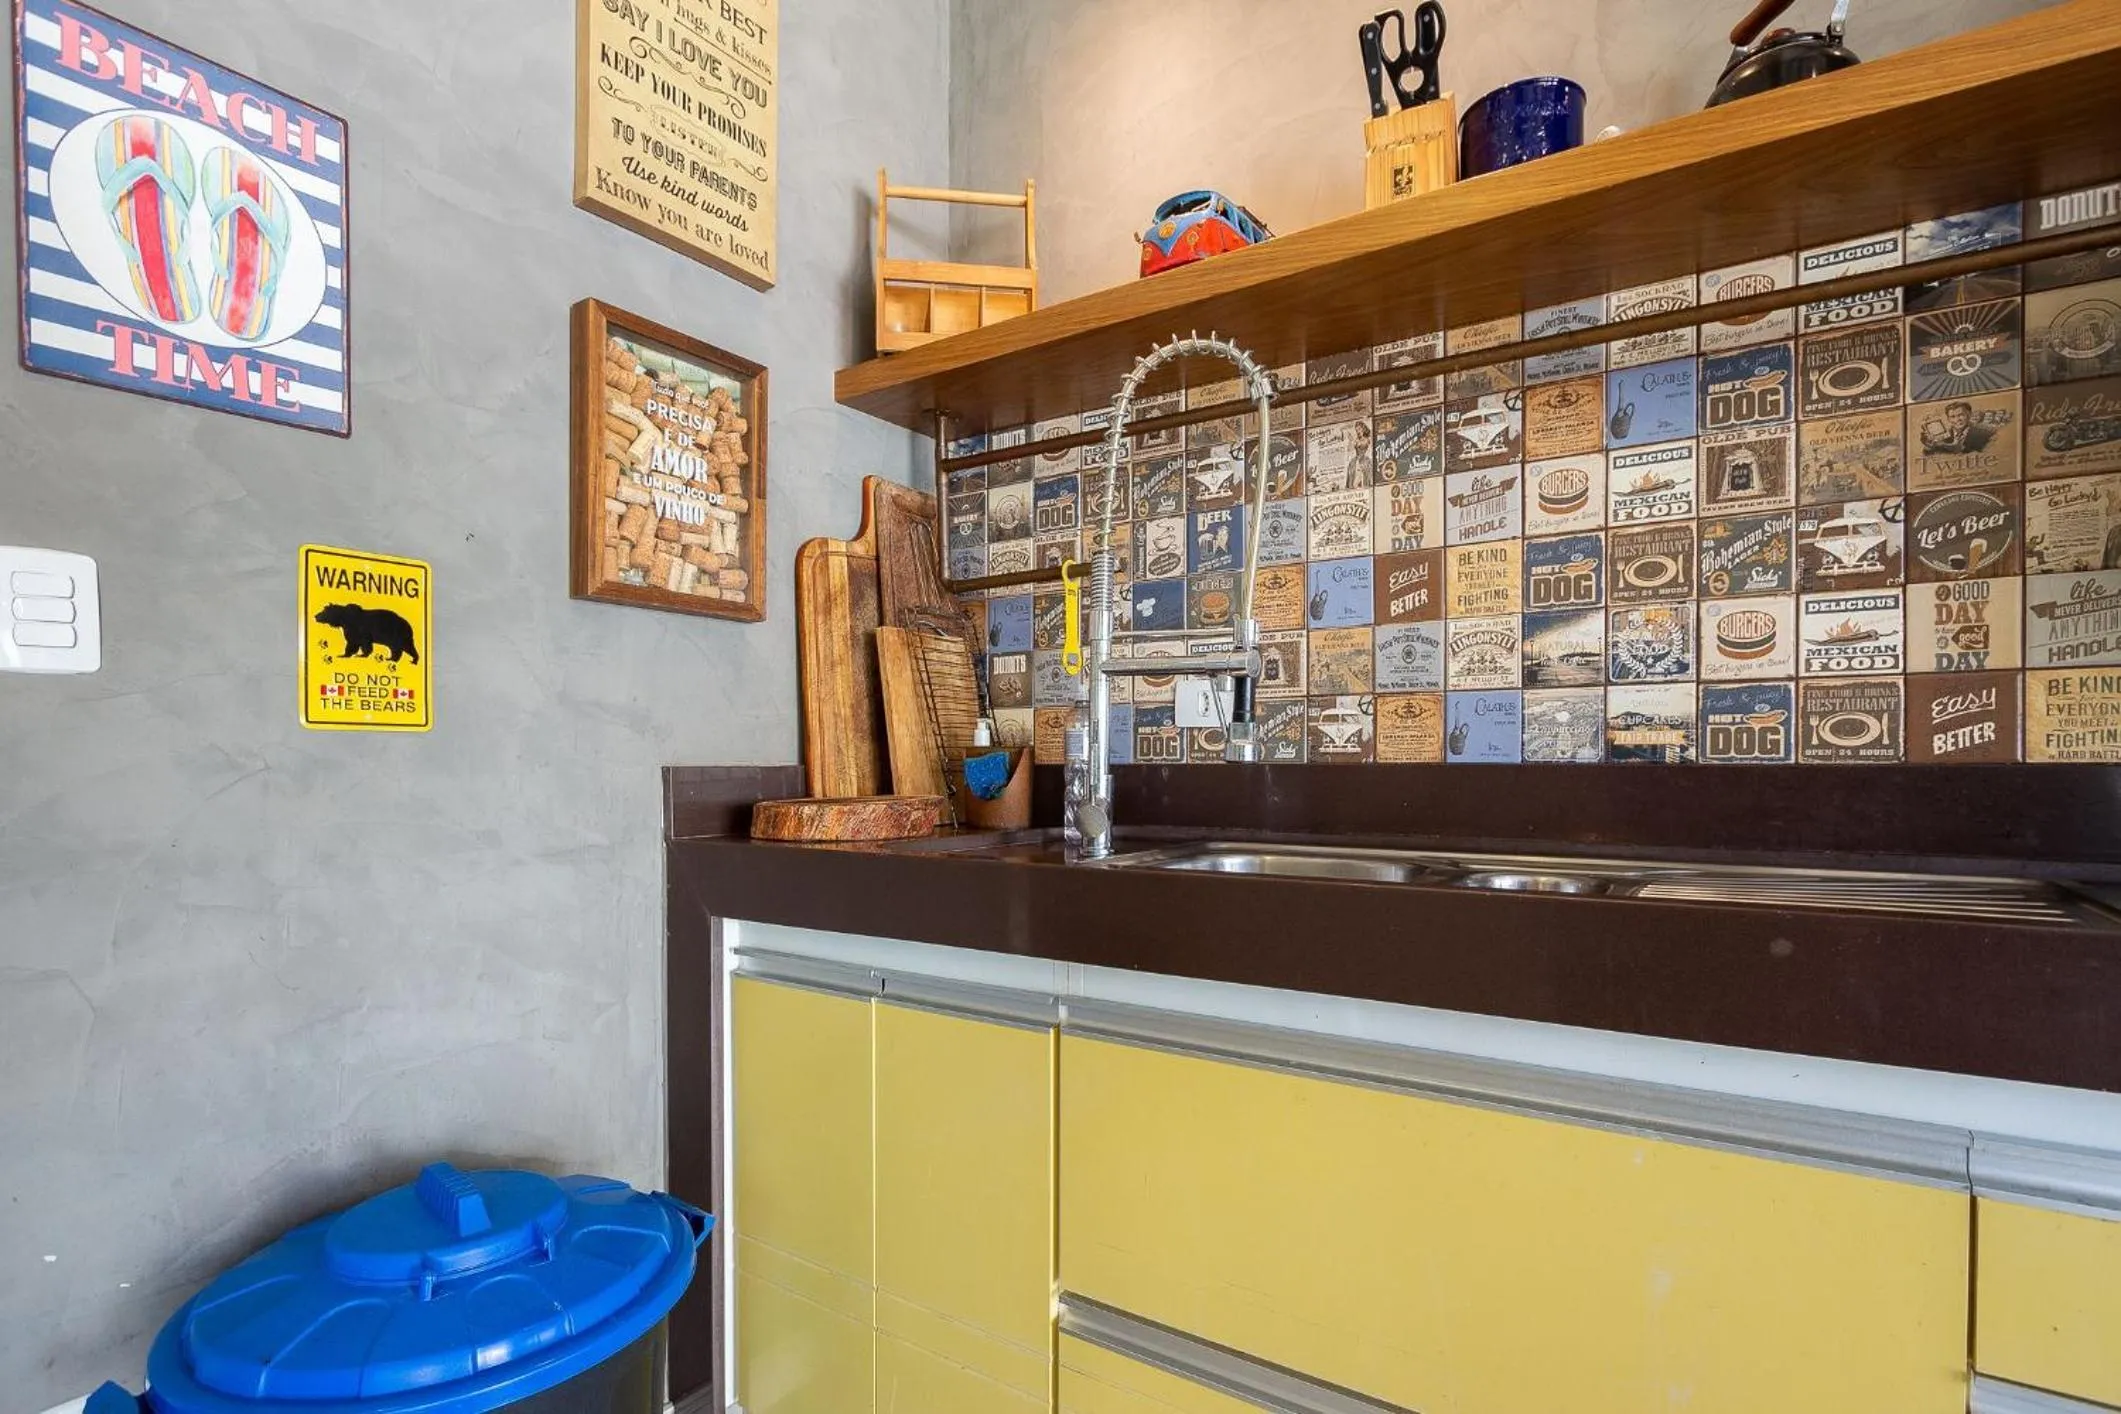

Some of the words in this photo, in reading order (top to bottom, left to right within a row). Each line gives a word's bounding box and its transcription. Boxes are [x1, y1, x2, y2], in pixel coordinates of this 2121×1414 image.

[720, 1, 768, 45] BEST
[676, 3, 710, 36] hugs
[715, 26, 726, 46] &
[732, 36, 772, 75] kisses
[603, 0, 650, 32] SAY
[656, 19, 663, 44] I
[669, 27, 722, 82] LOVE
[729, 66, 768, 109] YOU
[54, 11, 321, 166] BEACH
[601, 42, 645, 84] KEEP
[651, 72, 692, 114] YOUR
[699, 101, 767, 158] PROMISES
[612, 117, 635, 146] TO
[641, 132, 685, 174] YOUR
[690, 160, 758, 212] PARENTS
[622, 156, 658, 185] Use
[661, 174, 701, 207] kind
[701, 200, 749, 233] words
[2040, 183, 2121, 230] DONUT
[594, 166, 651, 212] Know
[658, 203, 689, 232] you
[695, 224, 722, 248] are
[729, 232, 770, 272] loved
[1807, 240, 1894, 267] DELICIOUS
[1719, 275, 1774, 300] BURGERS
[1809, 301, 1894, 326] FOOD
[1806, 341, 1897, 368] RESTAURANT
[1930, 337, 1998, 359] BAKERY
[96, 320, 301, 413] TIME
[647, 399, 718, 434] PRECISA
[1706, 386, 1785, 428] DOG
[1702, 432, 1748, 445] OLDE
[1755, 425, 1791, 438] PUB
[652, 445, 709, 484] AMOR
[1615, 448, 1689, 467] DELICIOUS
[666, 482, 707, 501] POUCO
[1542, 470, 1587, 495] BURGERS
[654, 494, 705, 525] VINHO
[1391, 496, 1423, 516] DAY
[1614, 491, 1690, 508] MEXICAN
[1617, 502, 1689, 521] FOOD
[1037, 505, 1075, 531] DOG
[1197, 509, 1232, 531] BEER
[1459, 517, 1507, 541] HANDLE
[1917, 522, 1957, 549] Let's
[1961, 511, 2010, 535] Beer
[1391, 535, 1424, 552] DAY
[1459, 551, 1474, 566] BE
[1477, 548, 1507, 563] KIND
[316, 565, 420, 599] WARNING
[1389, 562, 1428, 588] Easy
[1457, 588, 1509, 606] FIGHTING
[1531, 573, 1596, 605] DOG
[1953, 581, 1990, 601] GOOD
[2070, 578, 2106, 600] life
[1390, 588, 1429, 617] BETTER
[1807, 597, 1895, 613] DELICIOUS
[1935, 601, 1990, 625] DAY
[1720, 612, 1773, 639] BURGERS
[1959, 627, 1987, 647] good
[2048, 609, 2121, 641] ANYTHIN
[1192, 644, 1234, 653] DELICIOU
[1806, 644, 1897, 657] MEXICAN
[2048, 637, 2121, 663] HANDLE
[1809, 656, 1895, 671] FOOD
[1935, 651, 1990, 671] DAY
[334, 672, 359, 685] DO
[367, 674, 402, 687] NOT
[348, 685, 389, 698] FEED
[2048, 677, 2074, 697] BE
[320, 697, 354, 711] THE
[360, 700, 416, 713] BEARS
[1806, 697, 1898, 712] RESTAURANT
[1932, 687, 1996, 720] Easy
[2046, 702, 2121, 717] EVERYON
[1137, 735, 1179, 759] DOG
[1706, 725, 1785, 758] DOG
[1932, 721, 1996, 755] BETTER
[2046, 727, 2121, 748] FIGHTIN
[1859, 748, 1895, 756] HOURS
[2088, 749, 2121, 761] BATTL
